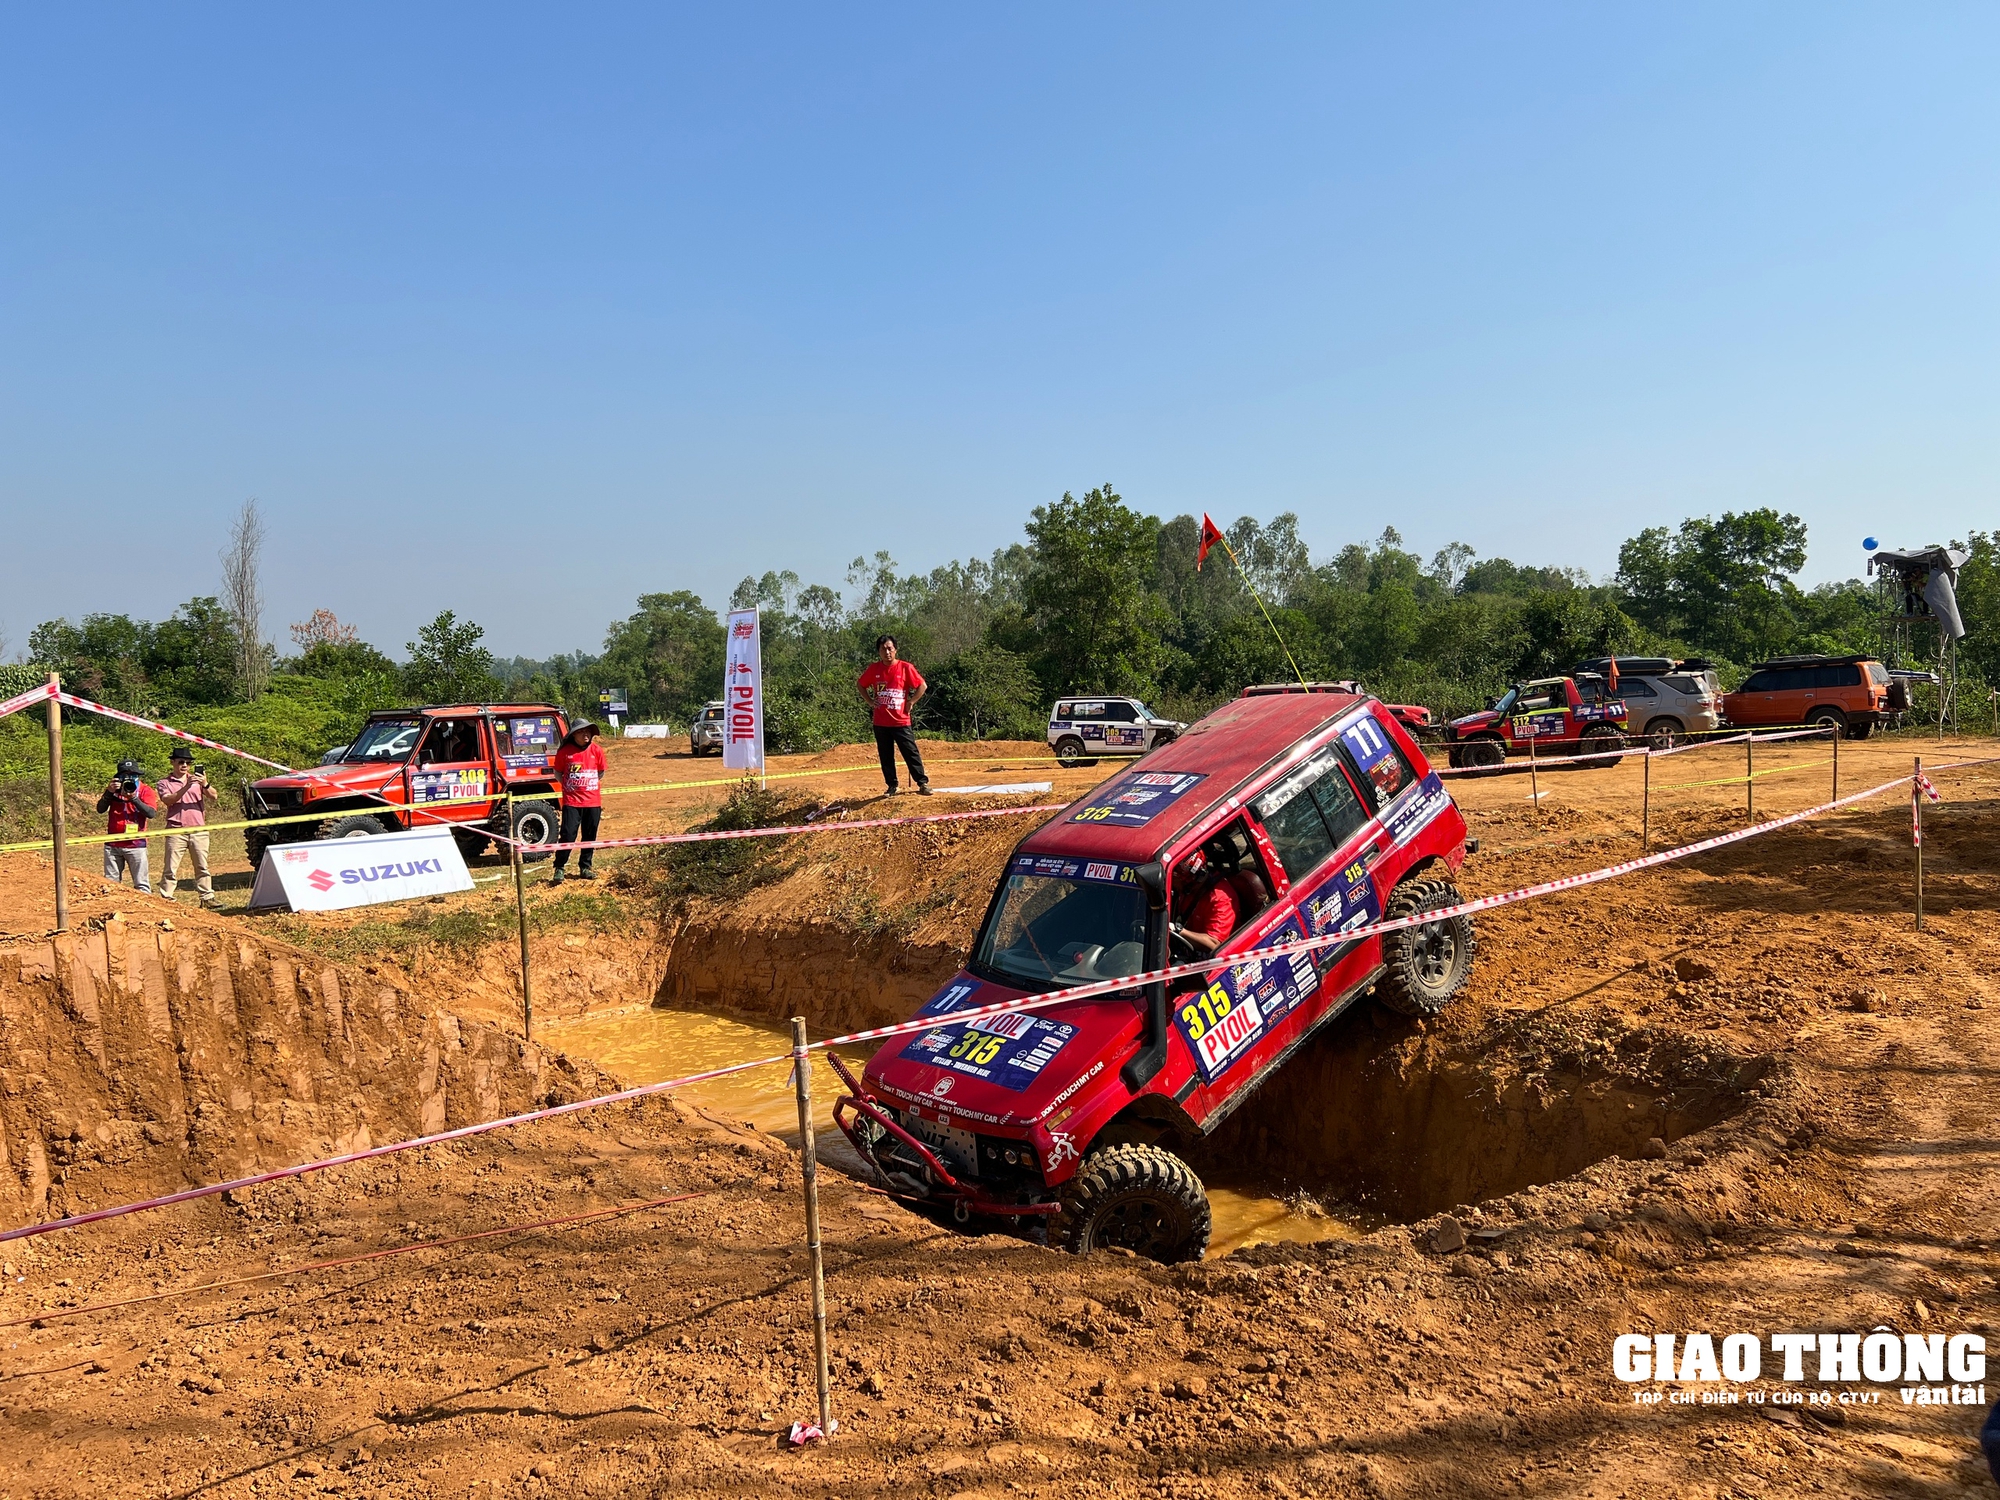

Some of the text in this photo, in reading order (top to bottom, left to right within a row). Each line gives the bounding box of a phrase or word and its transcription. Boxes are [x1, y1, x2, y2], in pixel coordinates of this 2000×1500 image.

[733, 686, 754, 744] PVOIL
[1513, 716, 1529, 726] 312
[1517, 726, 1537, 734] PVOIL
[459, 769, 486, 784] 308
[1139, 774, 1178, 784] PVOIL
[453, 784, 480, 797] PVOIL
[1075, 807, 1115, 820] 315
[339, 858, 443, 885] SUZUKI
[1087, 863, 1112, 879] PVOIL
[1120, 866, 1137, 884] 31
[1345, 862, 1363, 884] 315
[1312, 900, 1319, 914] 17
[1313, 895, 1341, 920] OFFROAD
[1330, 902, 1342, 917] CUP
[1182, 981, 1231, 1040] 315
[1034, 1020, 1056, 1031] Ford
[1054, 1030, 1069, 1039] TOYOTA
[1204, 1006, 1257, 1063] PVOIL
[949, 1030, 1007, 1065] 315
[1055, 1081, 1080, 1105] TOUCH
[1076, 1072, 1090, 1088] MY
[1089, 1061, 1104, 1076] CAR
[896, 1089, 913, 1101] TOUCH
[913, 1094, 922, 1107] MY
[922, 1097, 933, 1108] CAR
[953, 1106, 974, 1119] TOUCH
[973, 1110, 984, 1121] MY
[983, 1114, 998, 1123] CAR
